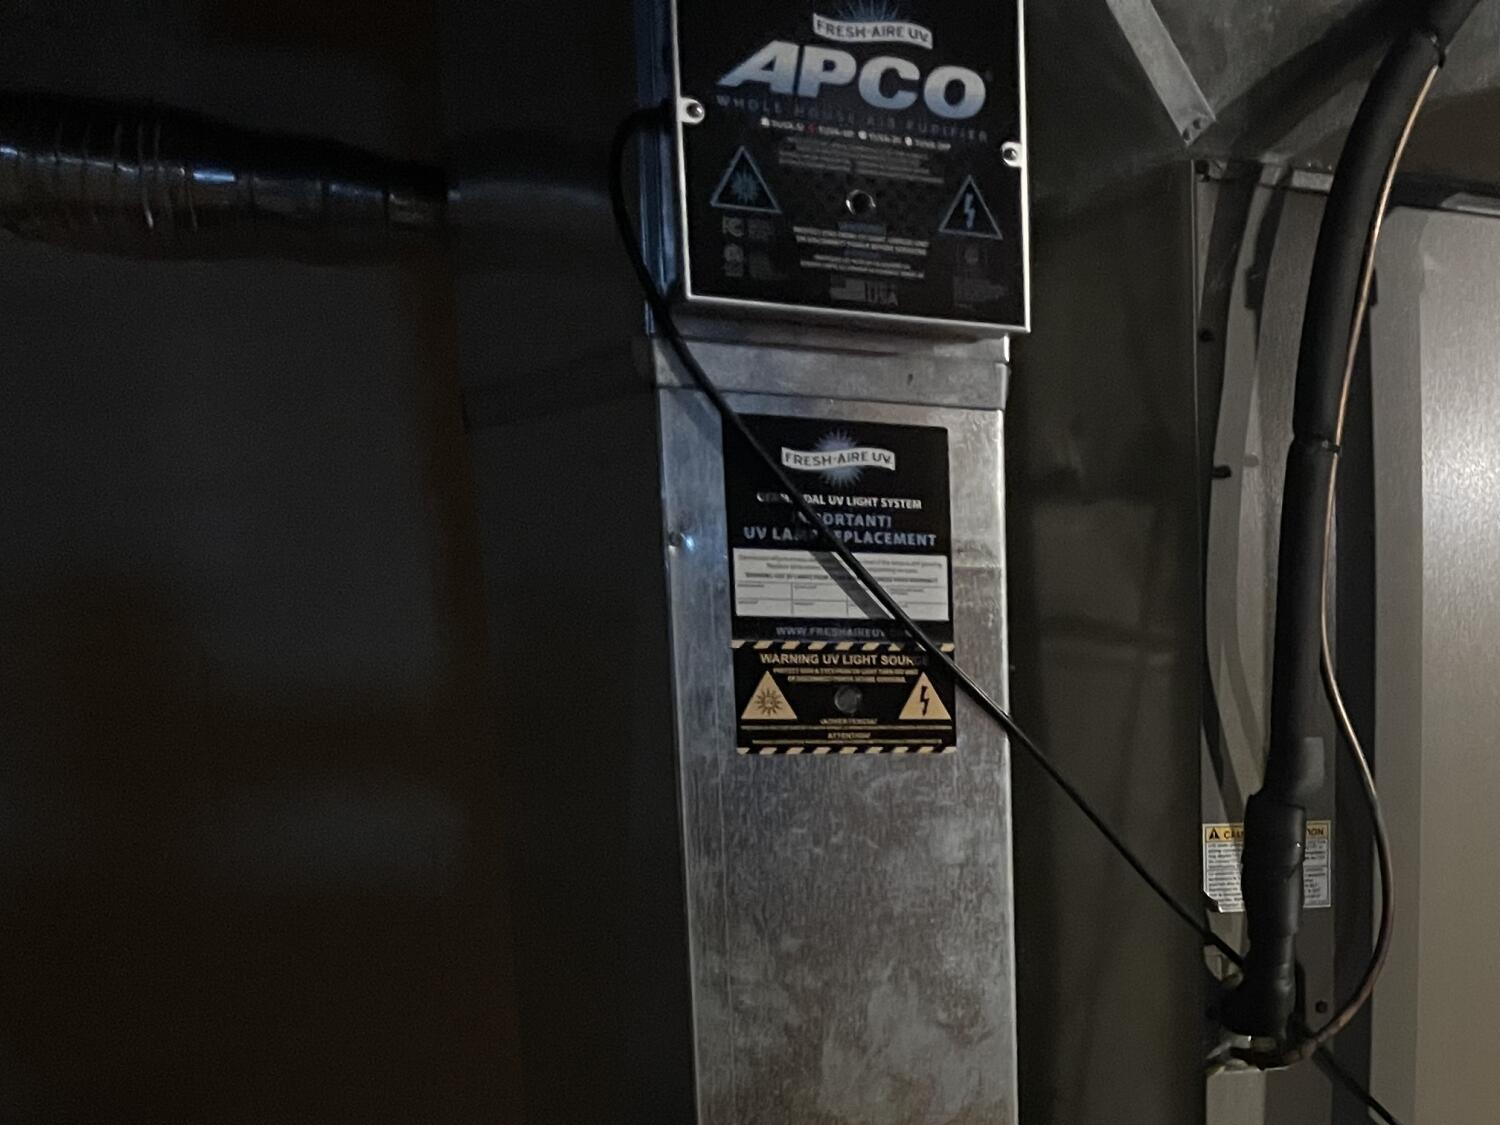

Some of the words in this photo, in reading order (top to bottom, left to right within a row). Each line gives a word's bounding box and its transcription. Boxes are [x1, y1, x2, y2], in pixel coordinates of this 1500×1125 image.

[908, 27, 929, 42] UV
[715, 40, 986, 119] APCO
[872, 452, 891, 464] UV
[828, 494, 845, 506] UV
[846, 495, 878, 508] LIGHT
[881, 497, 922, 510] SYSTEM
[743, 525, 767, 540] UV
[759, 653, 819, 665] WARNING
[822, 653, 839, 665] UV
[841, 654, 879, 666] LIGHT
